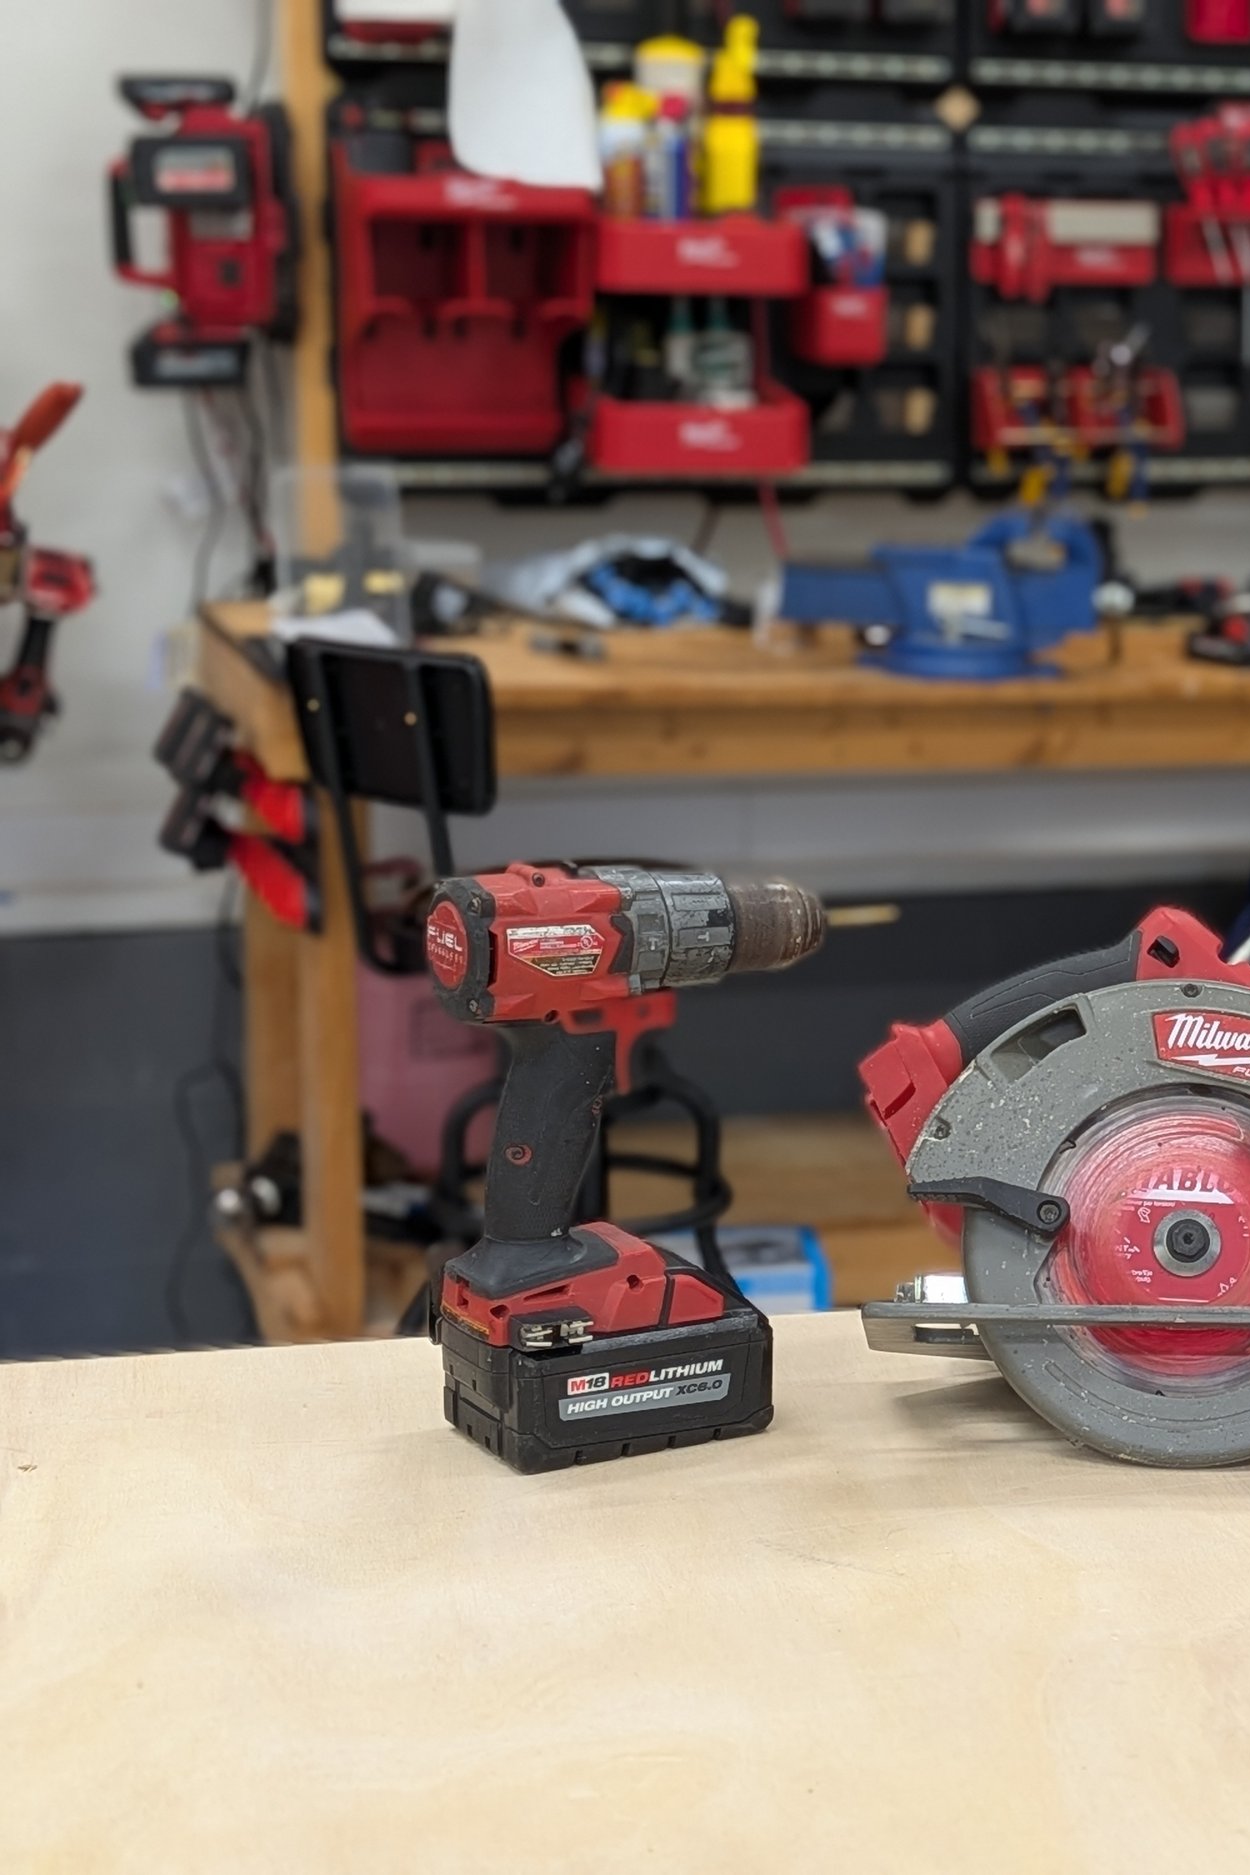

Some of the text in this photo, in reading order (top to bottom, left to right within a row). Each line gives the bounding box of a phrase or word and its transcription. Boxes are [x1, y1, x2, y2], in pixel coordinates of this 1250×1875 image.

[427, 925, 464, 952] FUEL
[570, 1359, 724, 1393] M18 REDLITHIUM
[567, 1379, 723, 1415] HIGH OUTPUT XC6.0
